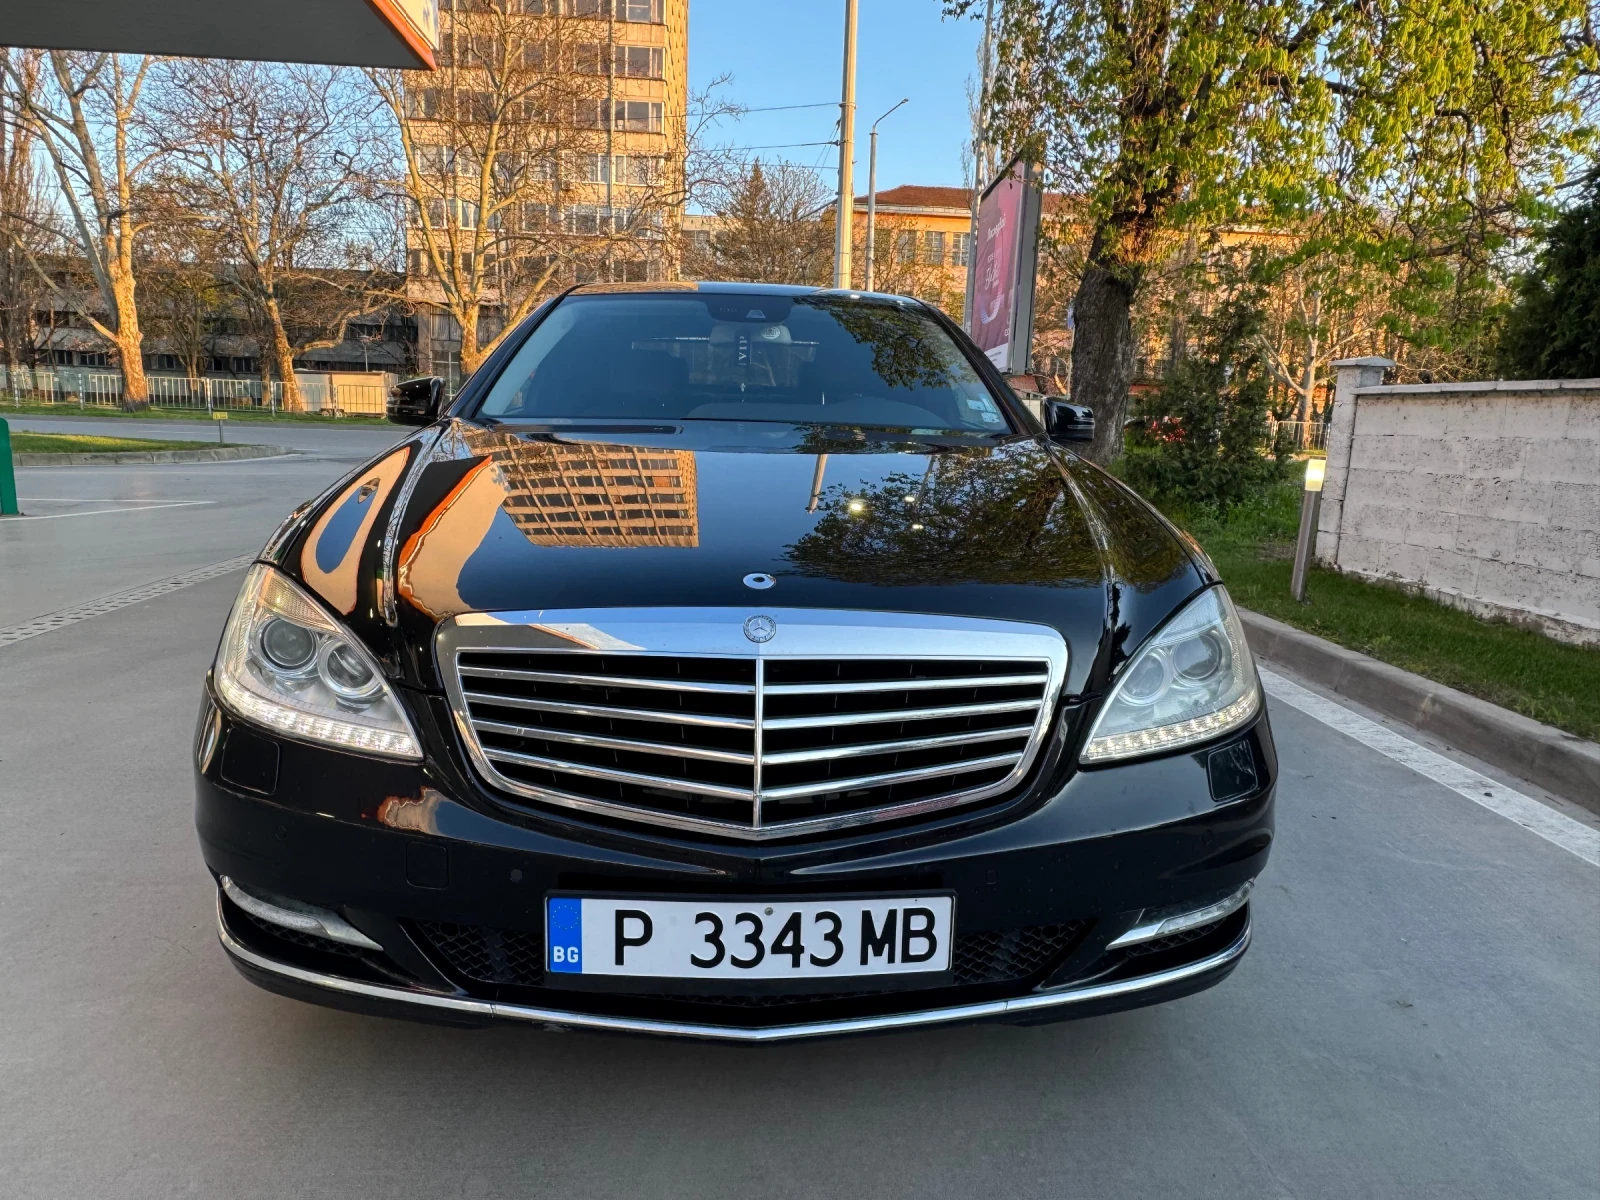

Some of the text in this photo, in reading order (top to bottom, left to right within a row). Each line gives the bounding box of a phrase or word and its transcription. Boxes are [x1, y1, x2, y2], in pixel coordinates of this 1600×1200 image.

[552, 946, 579, 964] BG
[614, 907, 938, 969] P 3343 MB
